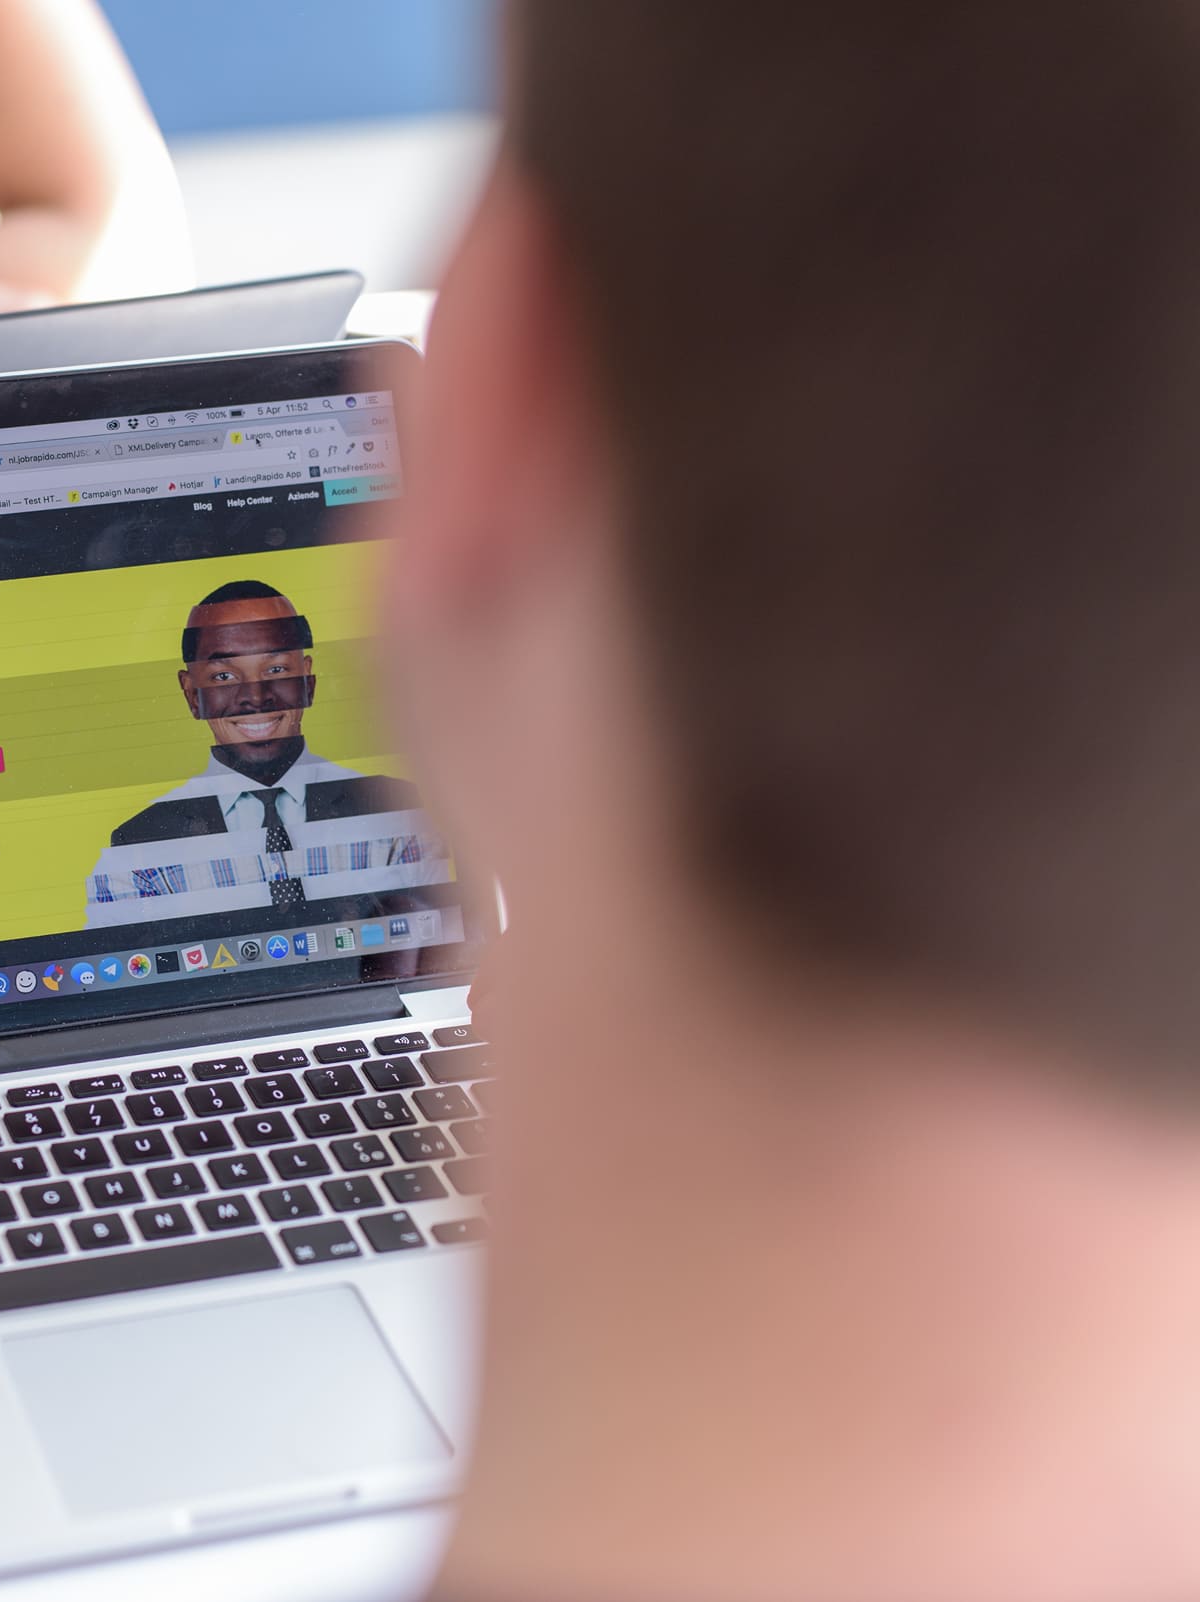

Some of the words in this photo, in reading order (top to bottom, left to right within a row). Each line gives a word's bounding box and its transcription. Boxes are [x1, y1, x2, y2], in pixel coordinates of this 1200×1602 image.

[206, 410, 227, 420] 100%
[258, 407, 263, 415] 5
[266, 406, 280, 415] Apr
[286, 403, 309, 412] 11:52
[276, 429, 302, 438] Offerte
[128, 440, 176, 452] XMLDelivery
[180, 480, 204, 489] Hotjar
[226, 473, 283, 485] LandingRapido
[286, 471, 301, 480] App
[82, 489, 122, 500] Campaign
[124, 485, 158, 496] Manager
[332, 487, 357, 496] Accedi
[24, 497, 41, 505] Test
[194, 502, 212, 511] Blog
[227, 498, 245, 508] Help
[248, 495, 273, 505] Center
[32, 1124, 42, 1134] 6
[91, 1116, 101, 1126] 7
[154, 1107, 164, 1117] 8
[213, 1098, 223, 1108] 9
[12, 1157, 24, 1170] T
[73, 1148, 86, 1160] Y
[135, 1139, 150, 1150] U
[257, 1122, 272, 1133] O
[319, 1113, 331, 1124] P
[43, 1191, 60, 1204] G
[105, 1180, 124, 1195] H
[172, 1173, 182, 1185] J
[231, 1162, 247, 1176] K
[293, 1155, 307, 1166] L
[27, 1231, 43, 1247] V
[155, 1213, 174, 1228] N
[217, 1204, 239, 1218] M
